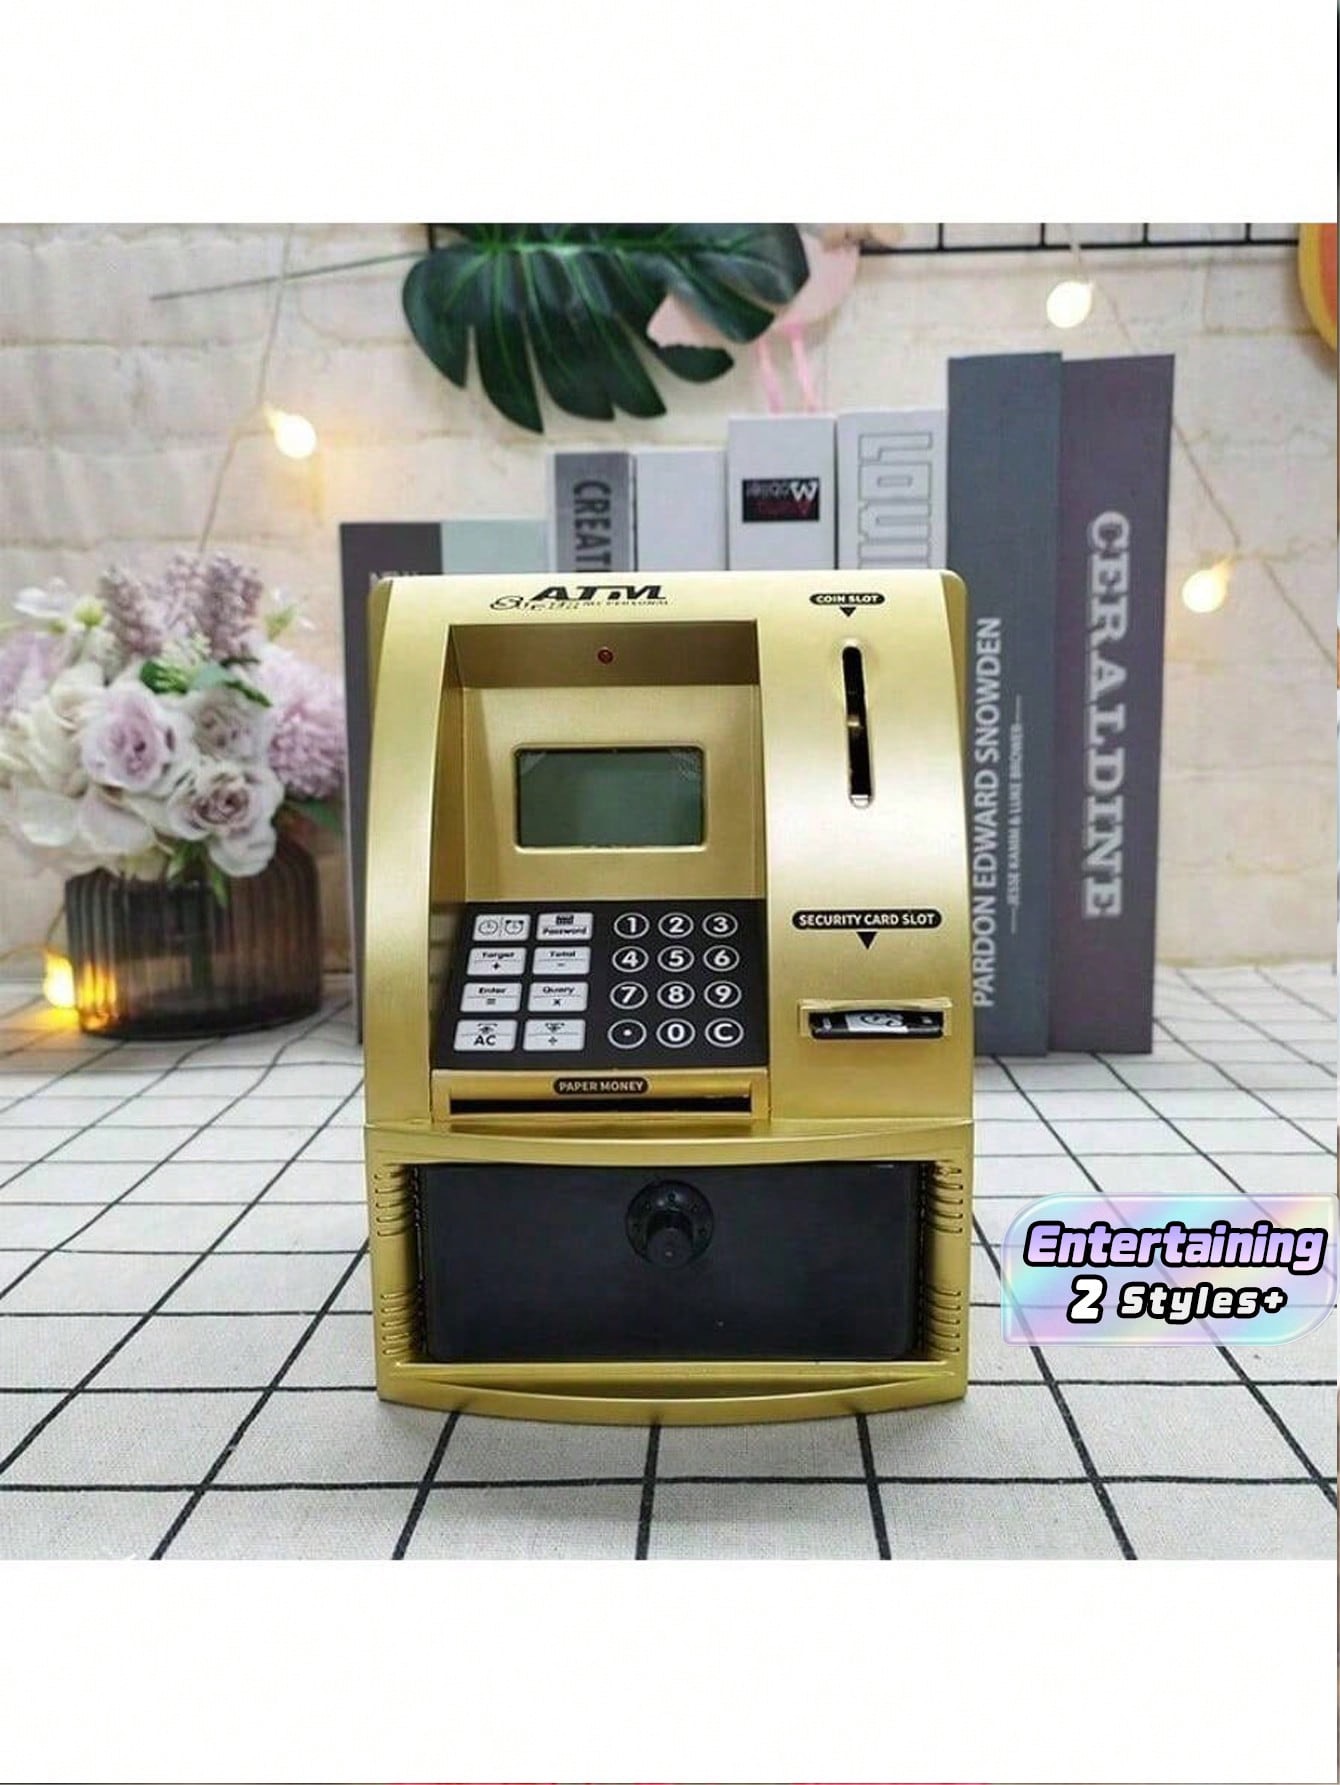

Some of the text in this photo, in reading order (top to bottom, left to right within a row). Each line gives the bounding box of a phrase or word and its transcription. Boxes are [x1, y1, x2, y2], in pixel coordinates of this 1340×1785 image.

[815, 594, 880, 604] COIN SLOT
[1083, 510, 1130, 918] CERALDINE
[972, 617, 1001, 1008] PARDON EDWARD SNOWDEN
[627, 917, 729, 934] 1 2 3
[799, 913, 935, 927] SECURITY CARD SLOT
[621, 949, 731, 968] 4 5 6
[543, 986, 575, 995] Query
[620, 984, 732, 1004] 7 8 9
[473, 1035, 497, 1046] AC
[667, 1022, 734, 1042] 0 C
[559, 1081, 644, 1092] PAPER MONEY
